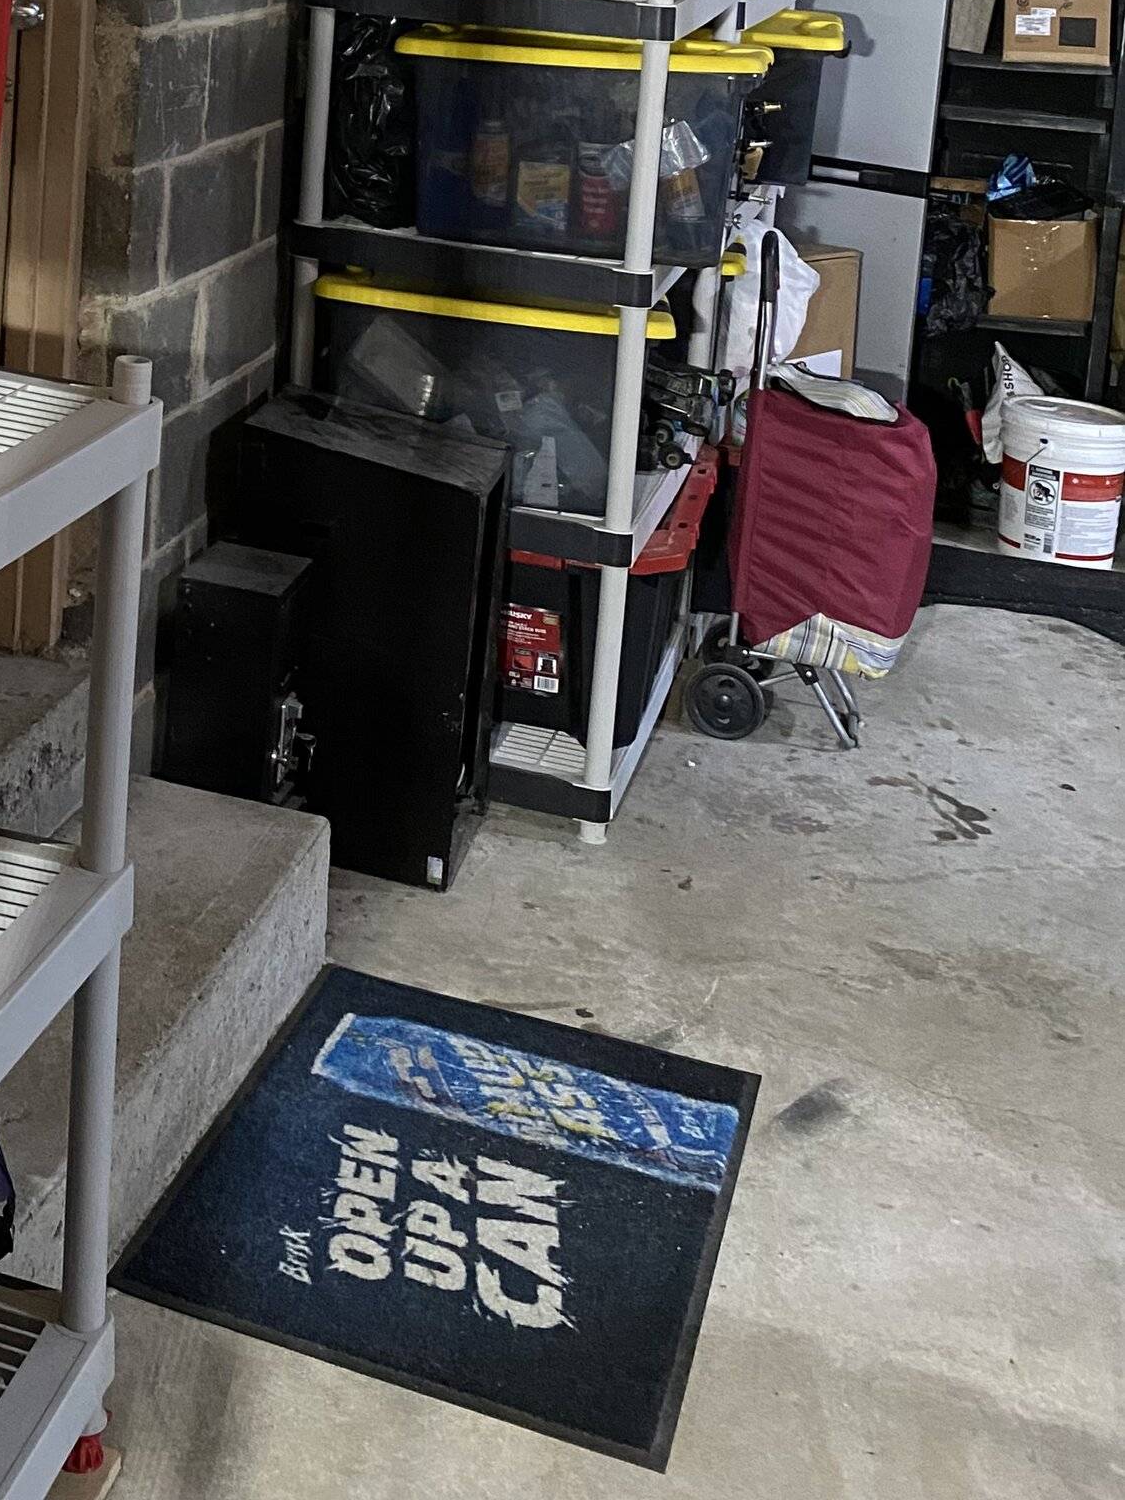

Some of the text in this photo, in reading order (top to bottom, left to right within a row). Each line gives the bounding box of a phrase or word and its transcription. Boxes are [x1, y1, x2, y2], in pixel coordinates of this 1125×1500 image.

[325, 1124, 399, 1281] OPEN
[402, 1150, 471, 1291] UP A
[475, 1155, 567, 1329] CAN
